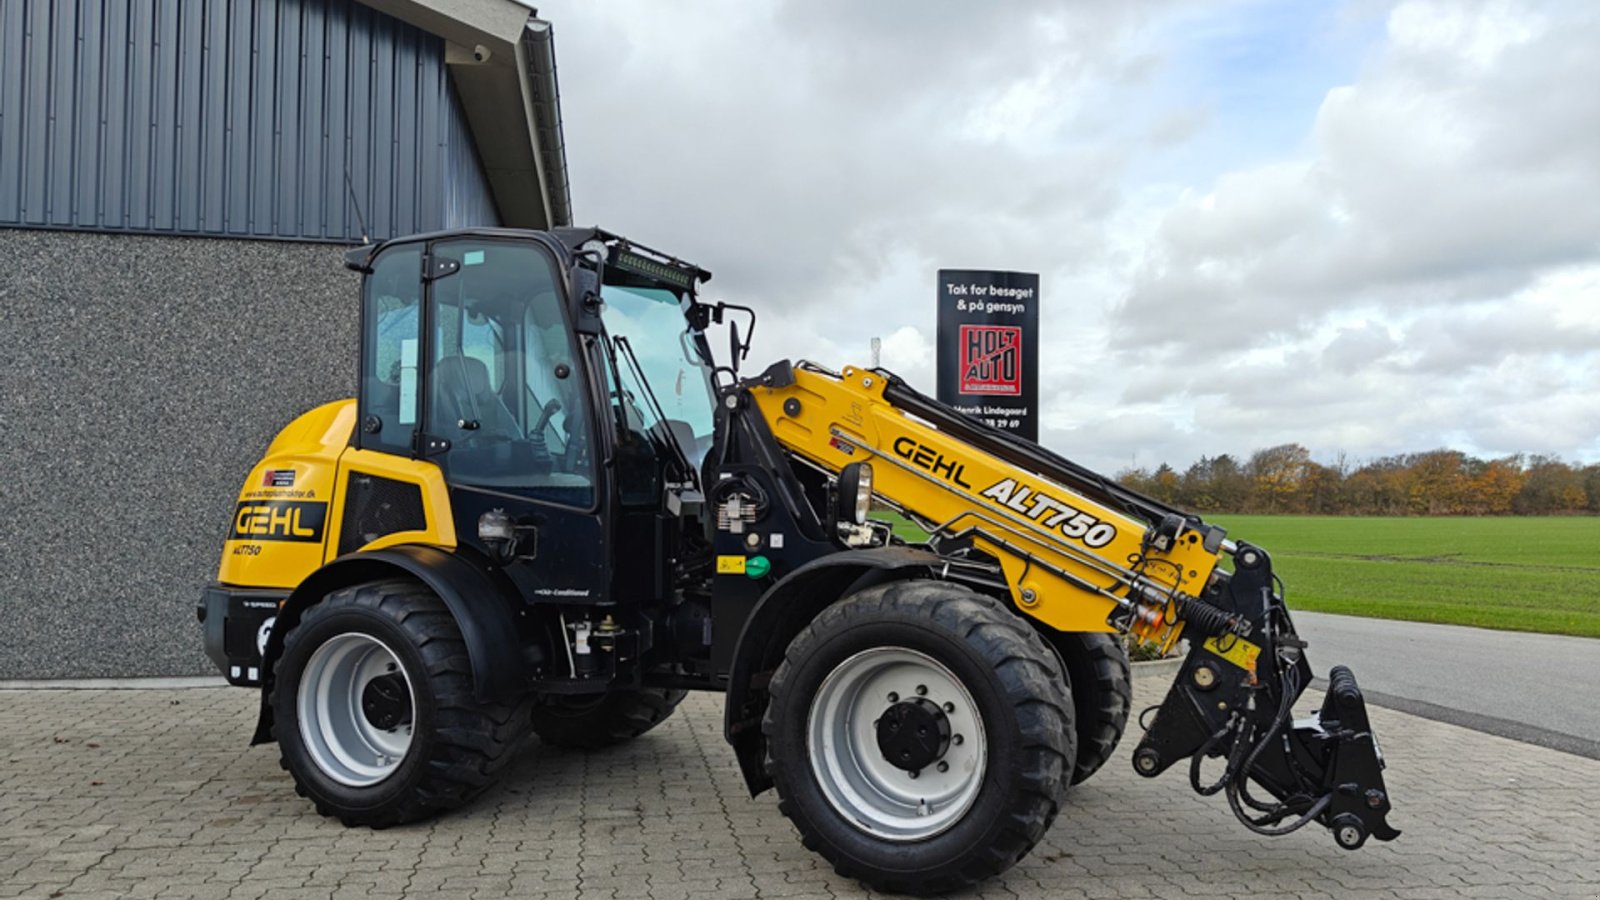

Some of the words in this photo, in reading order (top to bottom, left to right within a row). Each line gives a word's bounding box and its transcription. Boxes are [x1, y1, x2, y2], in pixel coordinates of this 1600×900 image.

[947, 284, 968, 295] Tak
[970, 284, 987, 295] for
[989, 285, 1034, 299] besøget
[956, 300, 967, 311] &
[968, 300, 985, 313] på
[986, 302, 1025, 314] gensyn
[967, 330, 1016, 363] HOLT
[965, 348, 1016, 381] AUTO
[983, 405, 1028, 417] Lindegaard
[893, 437, 971, 490] GEHL
[235, 506, 315, 537] GEHL
[978, 477, 1117, 549] ALT750
